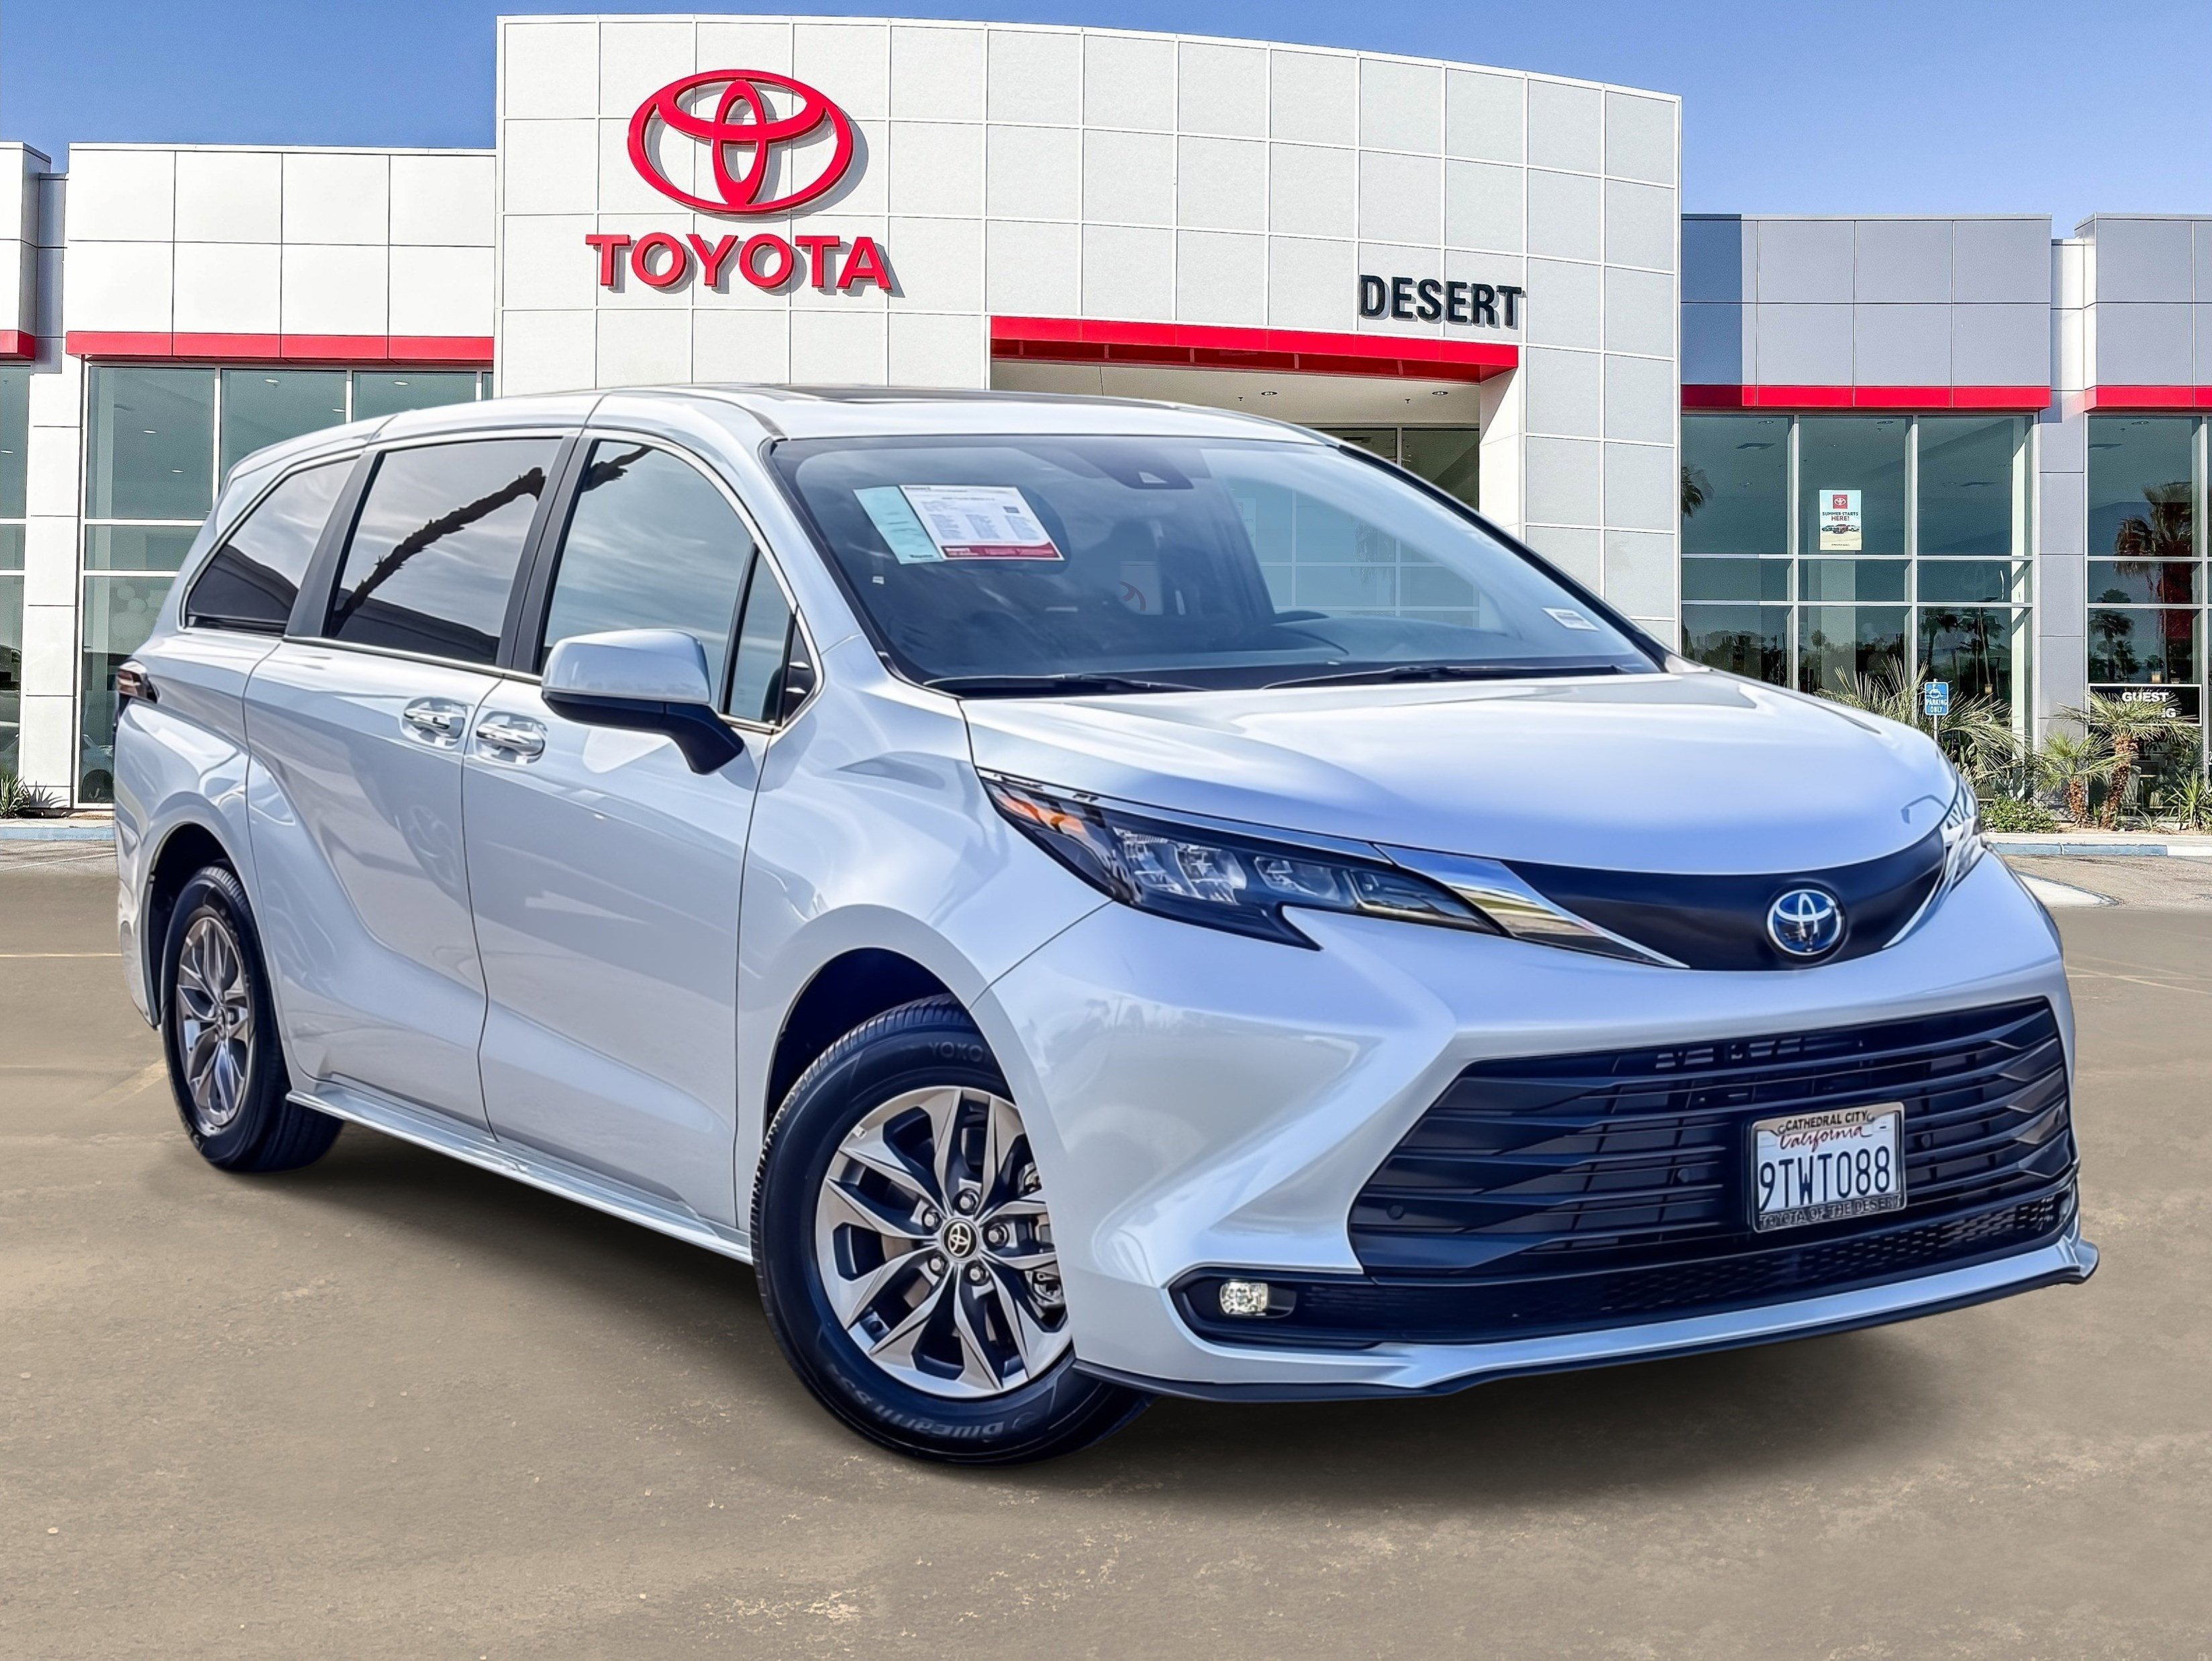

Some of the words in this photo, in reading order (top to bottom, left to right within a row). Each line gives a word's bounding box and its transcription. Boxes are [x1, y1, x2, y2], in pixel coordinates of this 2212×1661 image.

[585, 232, 893, 291] TOYOTA
[1359, 274, 1523, 327] DESERT
[1930, 705, 1944, 713] ONLY
[2121, 692, 2169, 703] GUEST
[1786, 1114, 1842, 1131] CATHEDRAL
[1846, 1110, 1868, 1123] CITY
[1780, 1125, 1873, 1152] California
[1759, 1146, 1890, 1212] 9TWT088
[1759, 1211, 1807, 1229] TOYOTA
[1809, 1208, 1827, 1220] OF
[1827, 1203, 1852, 1218] THE
[1854, 1194, 1901, 1214] DESERT
